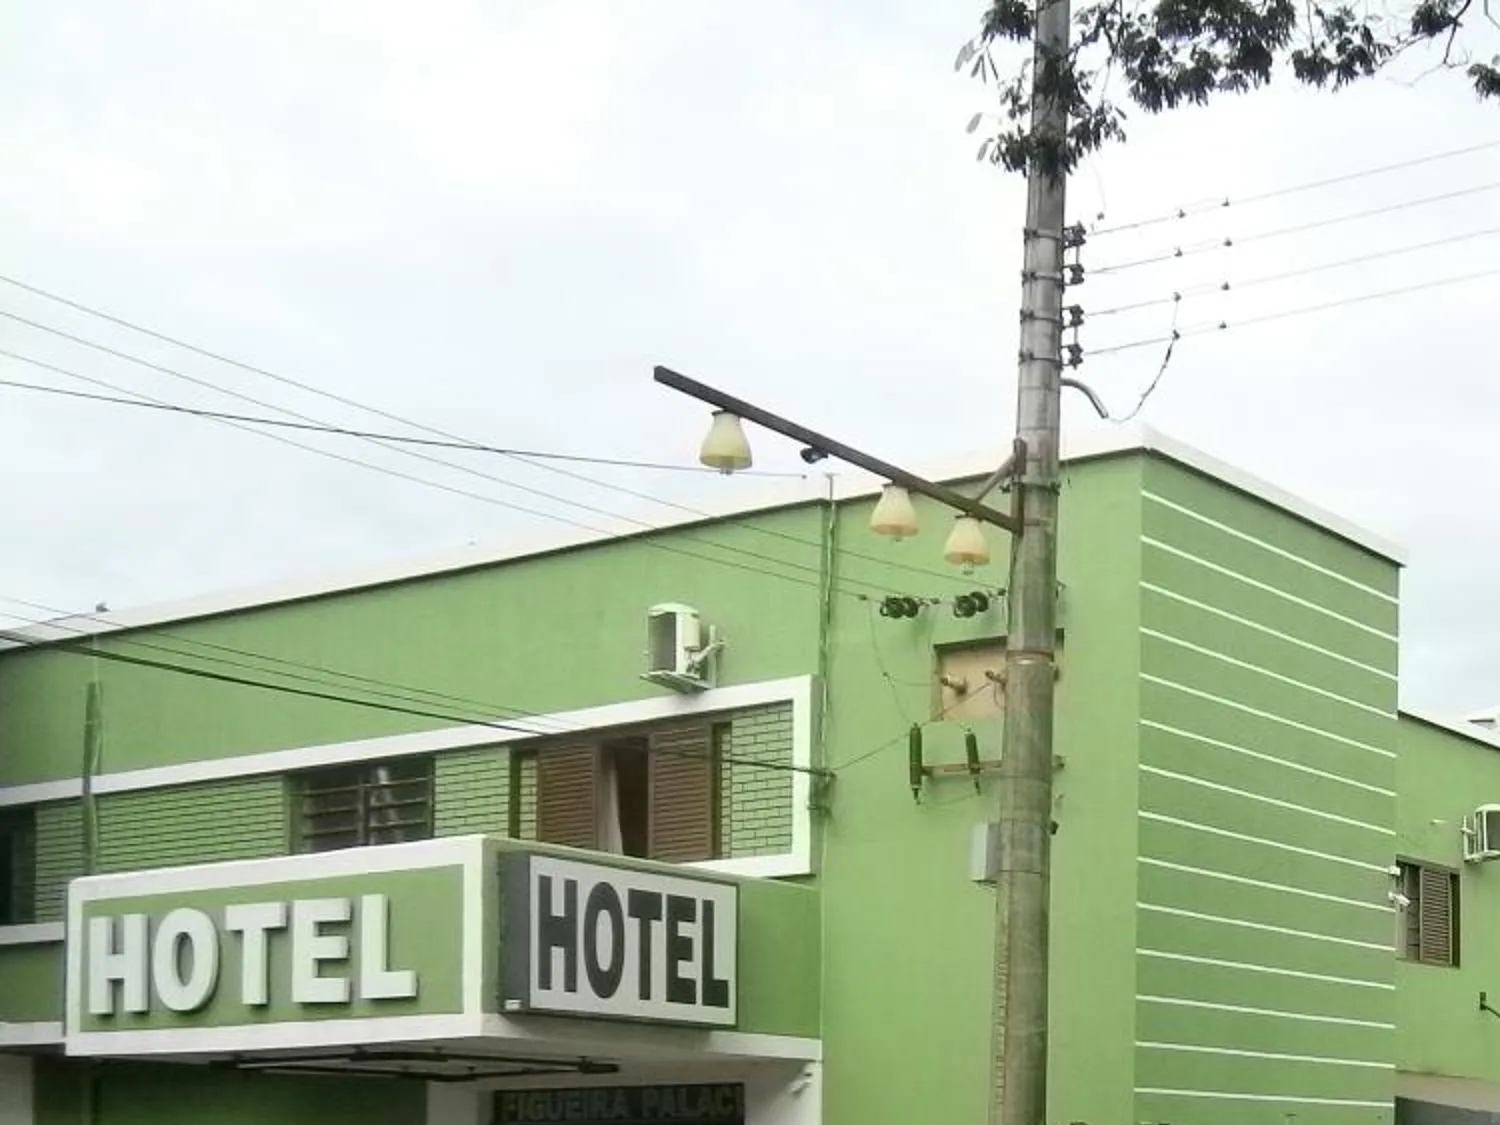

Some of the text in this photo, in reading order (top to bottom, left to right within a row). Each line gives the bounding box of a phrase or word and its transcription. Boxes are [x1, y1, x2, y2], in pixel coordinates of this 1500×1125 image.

[89, 893, 418, 1016] HOTEL
[538, 876, 730, 1009] HOTEL
[502, 1088, 630, 1121] FIGUEIRA
